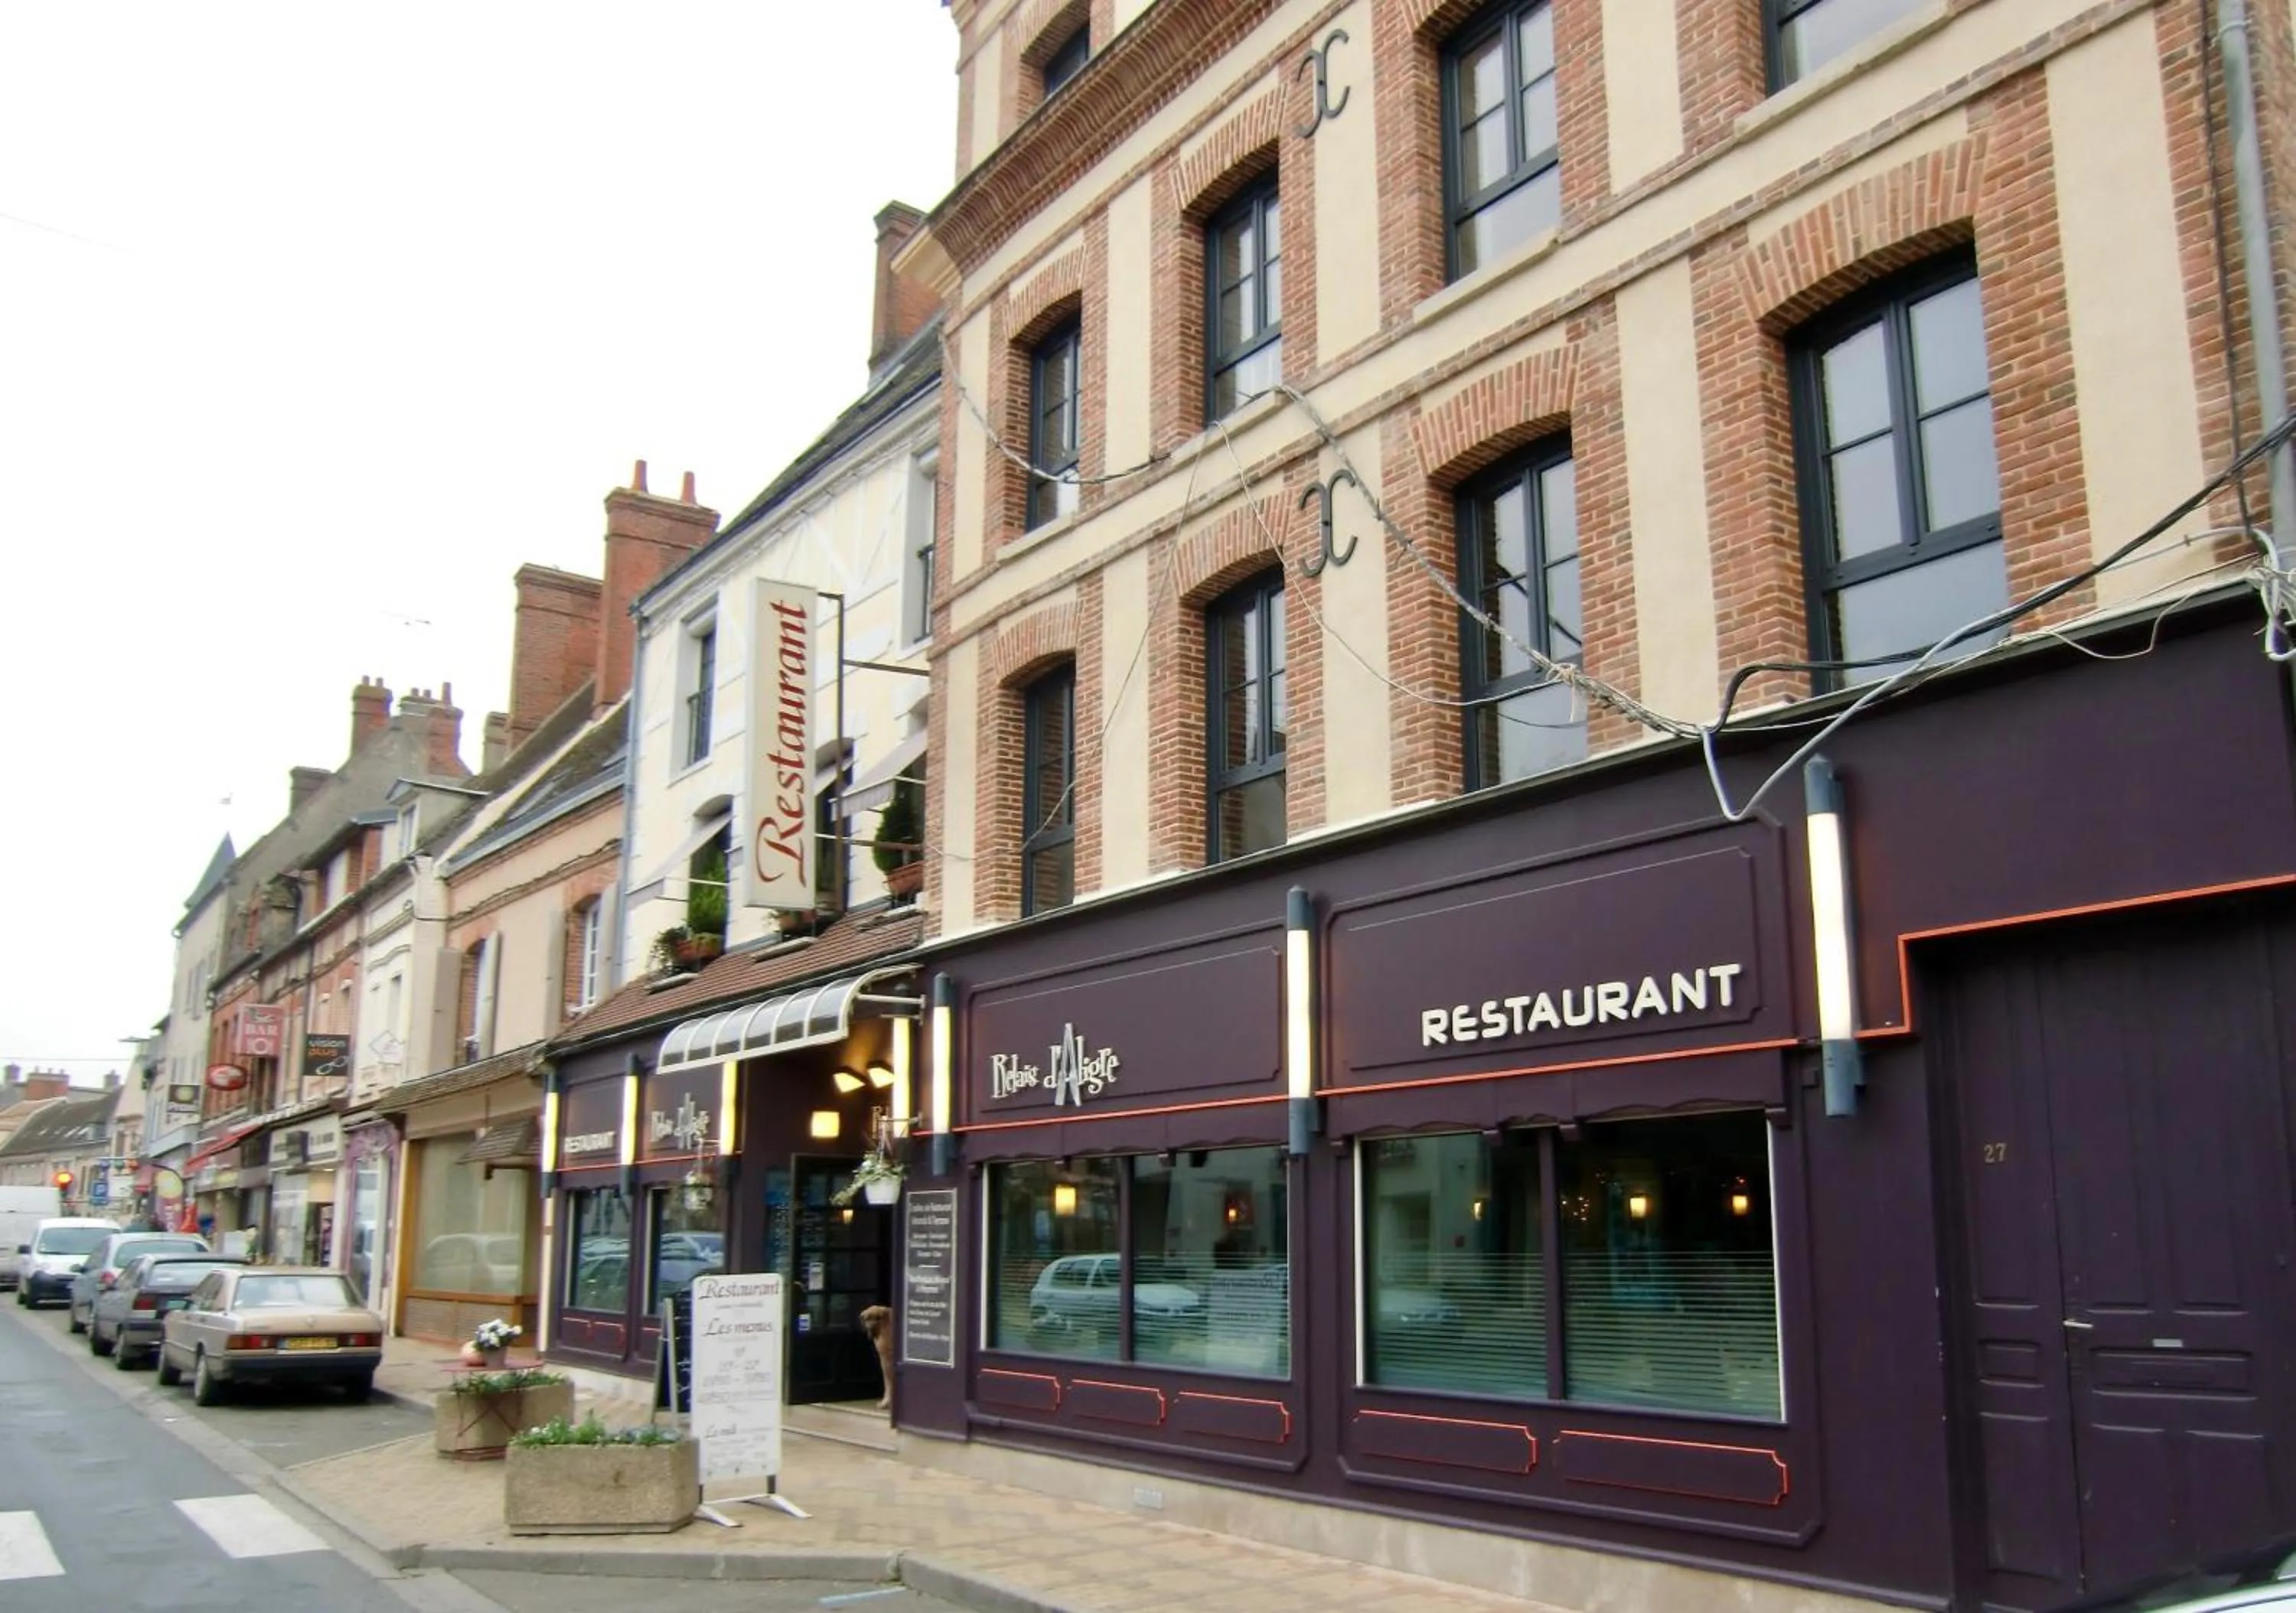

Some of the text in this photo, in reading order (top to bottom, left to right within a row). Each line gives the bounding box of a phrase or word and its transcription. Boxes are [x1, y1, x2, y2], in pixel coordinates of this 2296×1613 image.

[756, 599, 808, 888] Restaurant
[1421, 963, 1742, 1047] RESTAURANT
[245, 1023, 279, 1036] BAR
[990, 1053, 1040, 1098] Relais
[564, 1130, 615, 1154] RESTAURANT
[1983, 1142, 2007, 1163] 27
[698, 1279, 780, 1299] Restaurant
